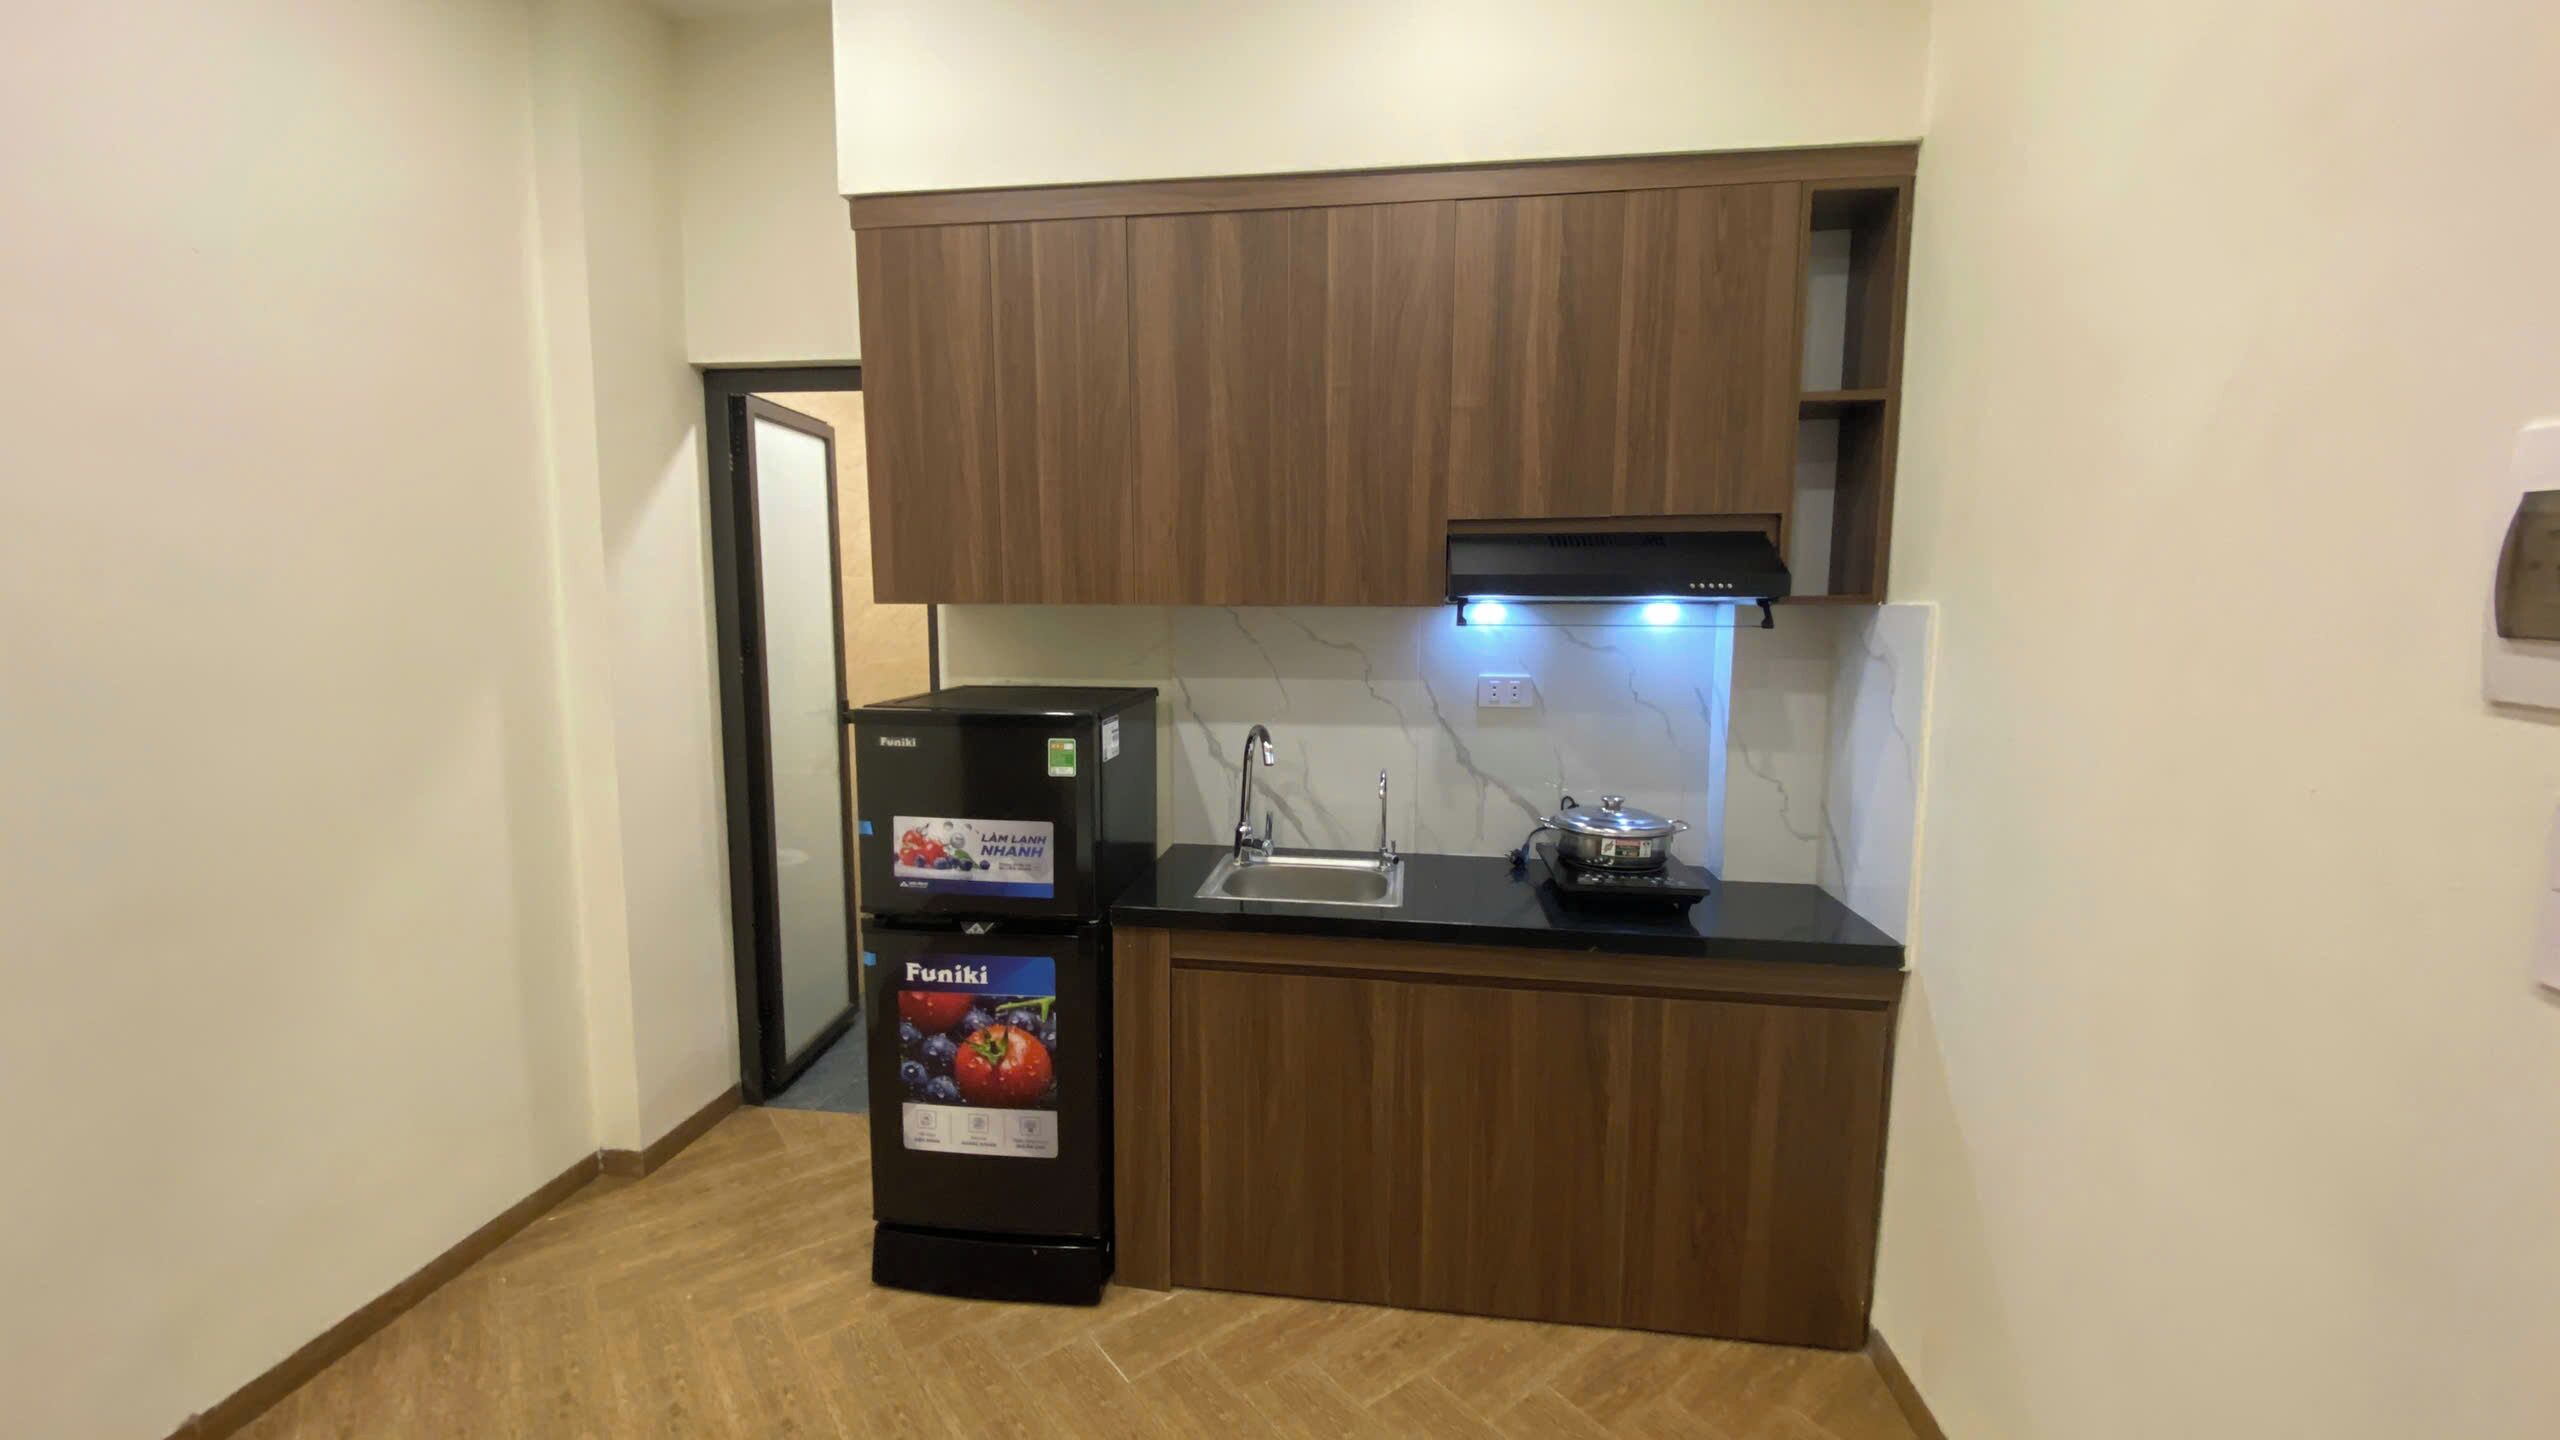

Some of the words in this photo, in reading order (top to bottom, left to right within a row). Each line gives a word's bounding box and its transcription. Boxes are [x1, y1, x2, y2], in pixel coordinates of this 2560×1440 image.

[880, 736, 916, 747] Funiki
[981, 845, 1043, 857] NHANH
[905, 962, 988, 984] Funiki
